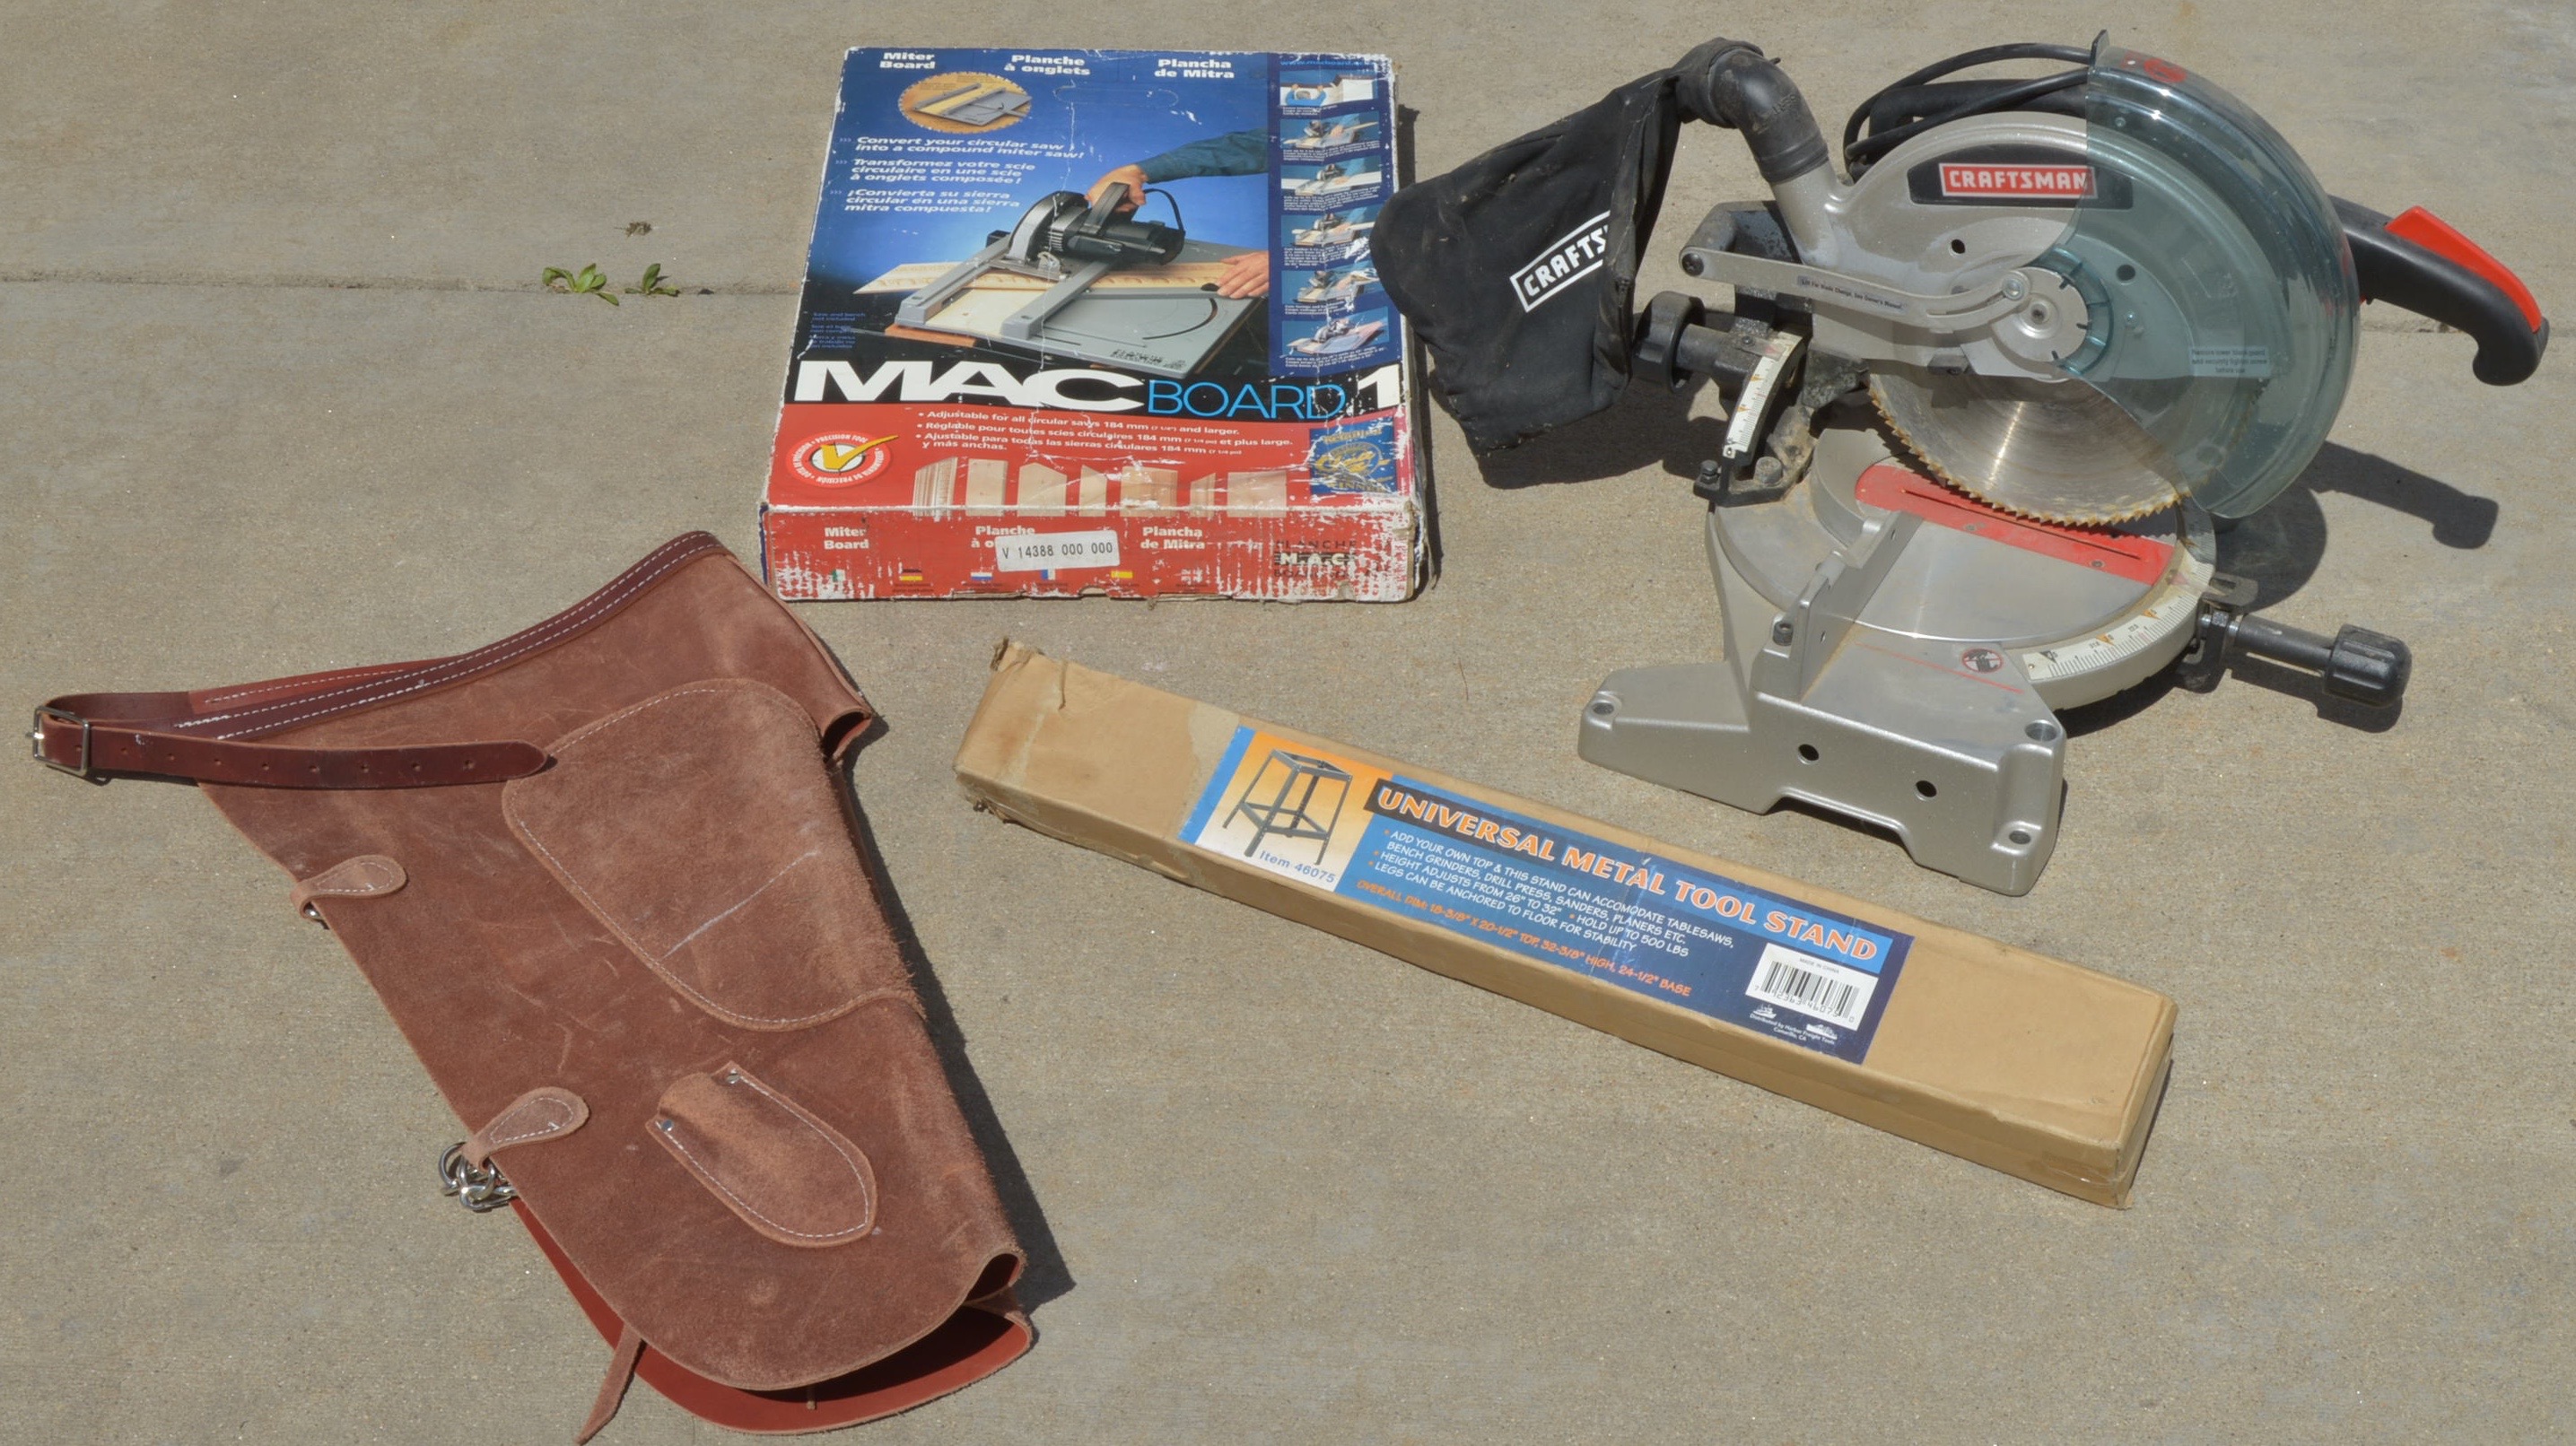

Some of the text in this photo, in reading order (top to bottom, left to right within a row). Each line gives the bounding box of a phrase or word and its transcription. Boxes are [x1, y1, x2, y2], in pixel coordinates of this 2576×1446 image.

[883, 51, 935, 61] Miter
[1011, 54, 1085, 65] Planche
[879, 60, 936, 70] Board
[1003, 62, 1091, 75] à onglets
[1157, 58, 1232, 69] Plancha
[1154, 68, 1235, 79] de Mitra
[857, 136, 1064, 151] Convert your circular saw
[855, 144, 888, 152] into
[913, 144, 994, 154] compound
[997, 146, 1041, 156] miter
[1043, 150, 1085, 159] saw!
[852, 158, 1036, 171] Transformez votre scie
[850, 173, 860, 181] à
[863, 173, 928, 183] onglets
[851, 166, 927, 175] circulaire
[956, 168, 987, 176] une
[991, 168, 1023, 178] scie
[1949, 170, 2090, 190] CRAFTSMAN
[847, 188, 937, 197] ¡Convierta
[963, 190, 1011, 199] sierra
[845, 196, 909, 205] circular
[971, 198, 1020, 207] sierra
[844, 204, 993, 213] mitra compuesta!
[1357, 363, 1401, 409] 1
[927, 411, 989, 420] Adjustable
[991, 414, 1009, 422] for
[1028, 416, 1068, 425] circular
[1204, 427, 1239, 436] larger.
[924, 432, 979, 441] Ajustable
[982, 436, 1008, 444] para
[1011, 438, 1043, 446] todas
[1065, 440, 1103, 449] sierras
[925, 422, 975, 431] Réglable
[978, 425, 1006, 433] pour
[1009, 427, 1045, 436] toutes
[1048, 429, 1074, 437] scies
[1137, 433, 1157, 441] 184
[1234, 439, 1258, 448] plus
[1261, 439, 1293, 448] large.
[933, 440, 959, 448] más
[961, 441, 1008, 450] anchas.
[824, 526, 866, 538] Miter
[975, 525, 1035, 536] Planche
[1142, 527, 1202, 538] Plancha
[824, 539, 869, 550] Board
[971, 537, 980, 548] à
[1140, 539, 1205, 550] de Mitra
[1002, 542, 1113, 559] V 14388 000 000
[1260, 849, 1336, 883] Item 46075
[1377, 787, 1878, 961] UNIVERSAL METAL TOOL STAND
[1386, 841, 1686, 945] BENCH GRINDERS, DRILL PRESS, SANDERS, PLANERS ETC.
[1390, 831, 1734, 949] ADD YOUR OWN TOP & THIS STAND CAN ACCOMODATE TABLESAWS,
[1375, 862, 1637, 952] LEGS CAN BE ANCHORED TO FLOOR FOR STABILITY
[1380, 851, 1690, 957] HEIGHT ADJUSTS FROM 26" TO 32" HOLD UP TO 500 LBS
[1357, 880, 1402, 902] OVERALL
[1541, 940, 1585, 960] 32-3/8"
[1585, 954, 1616, 973] HIGH,
[1618, 965, 1659, 985] 24-1/2"
[1659, 979, 1692, 997] BASE
